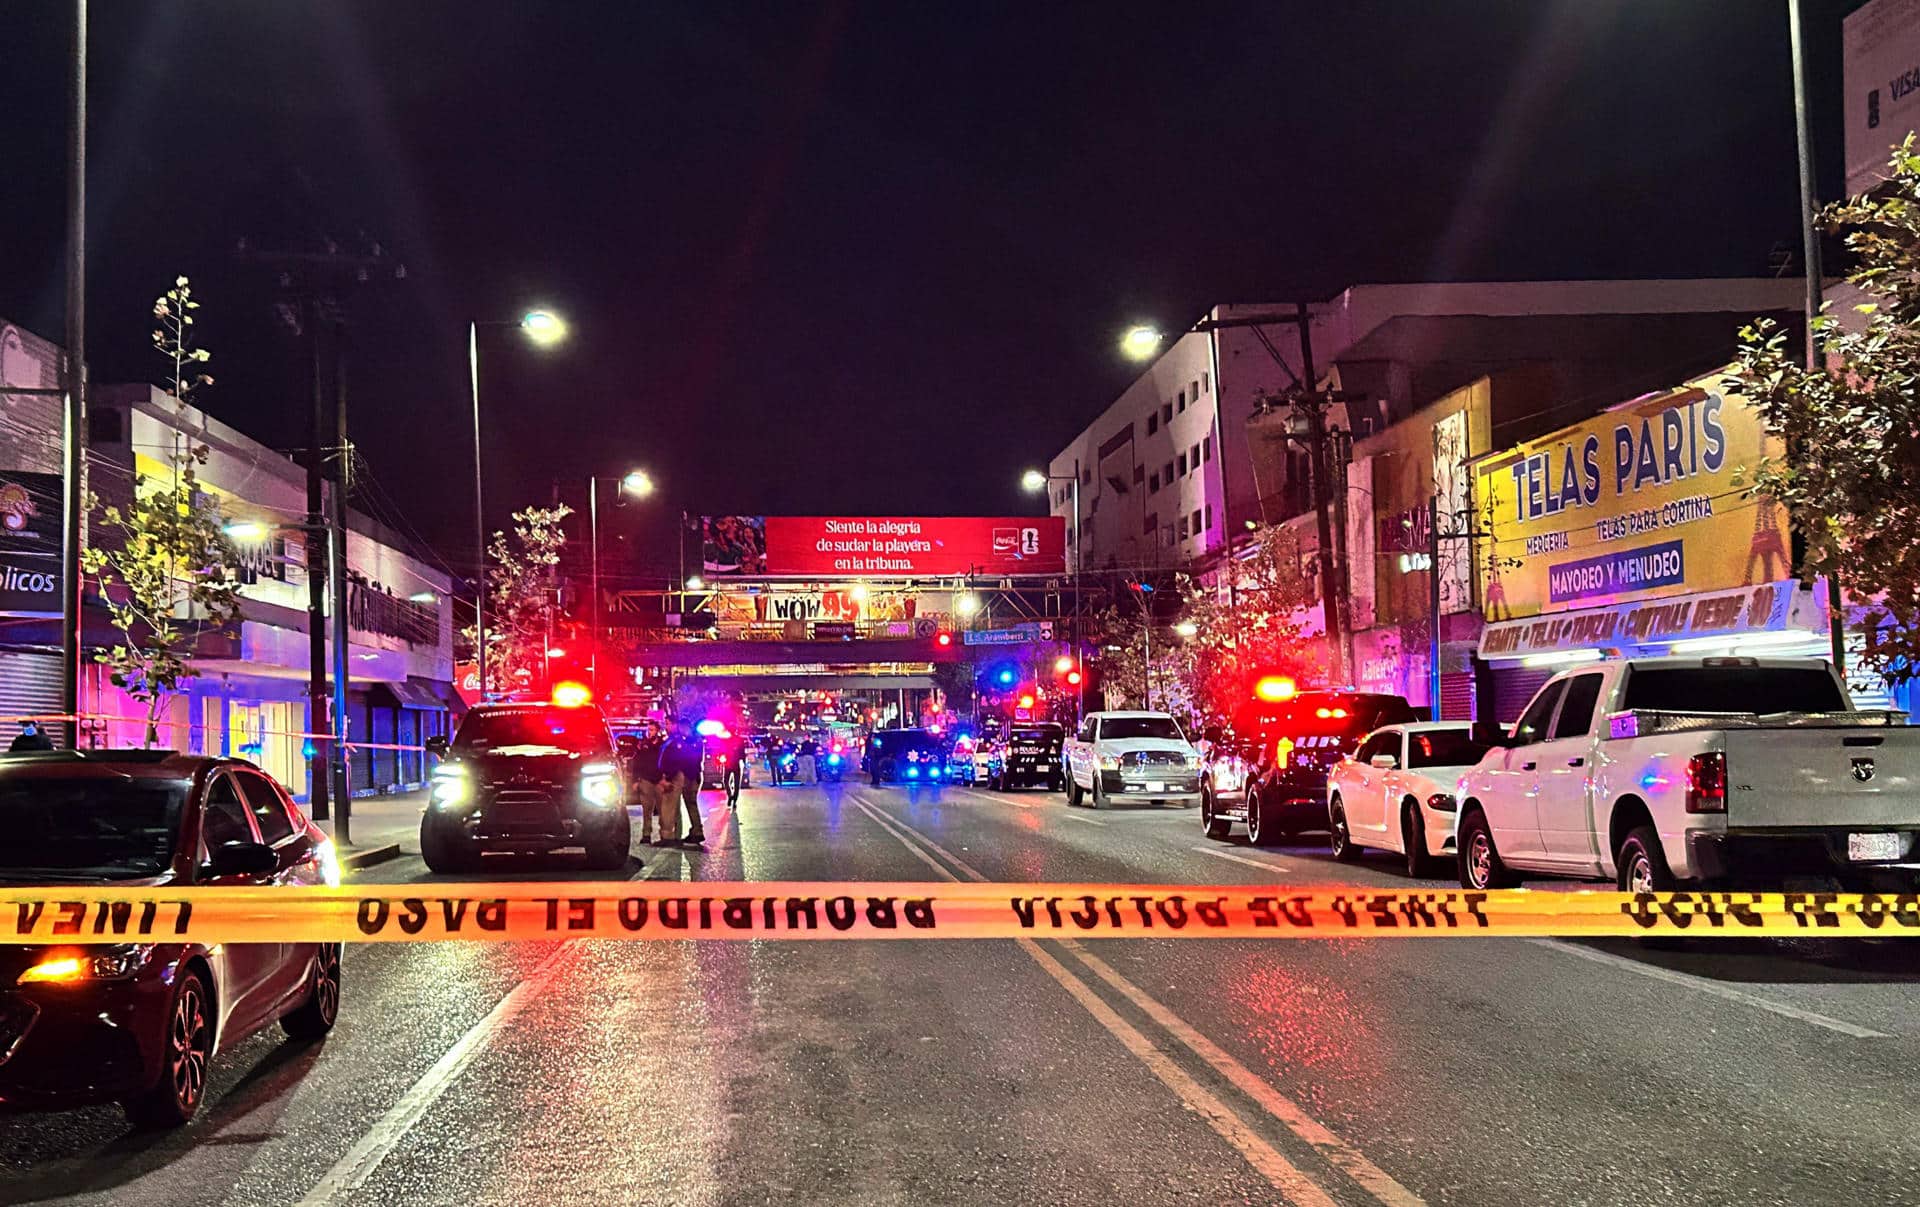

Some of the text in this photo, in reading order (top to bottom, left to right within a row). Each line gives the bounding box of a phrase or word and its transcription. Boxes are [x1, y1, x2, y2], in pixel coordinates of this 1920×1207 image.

[1512, 390, 1725, 523] TELAS PARIS
[825, 520, 864, 533] Siente
[866, 520, 877, 533] la
[1597, 495, 1713, 541] TELAS PARA CORTINA
[816, 538, 931, 554] de sudar la playera
[834, 556, 914, 570] en la tribuna.
[0, 566, 55, 592] licos
[1551, 550, 1680, 596] MAYOREO Y MENUDEO
[8, 900, 193, 935] LINEA
[356, 899, 507, 935] PASO
[544, 899, 595, 931] EL
[618, 897, 936, 931] PROHIBIDO
[1011, 896, 1228, 930] POLICIA
[1248, 896, 1314, 928] DE
